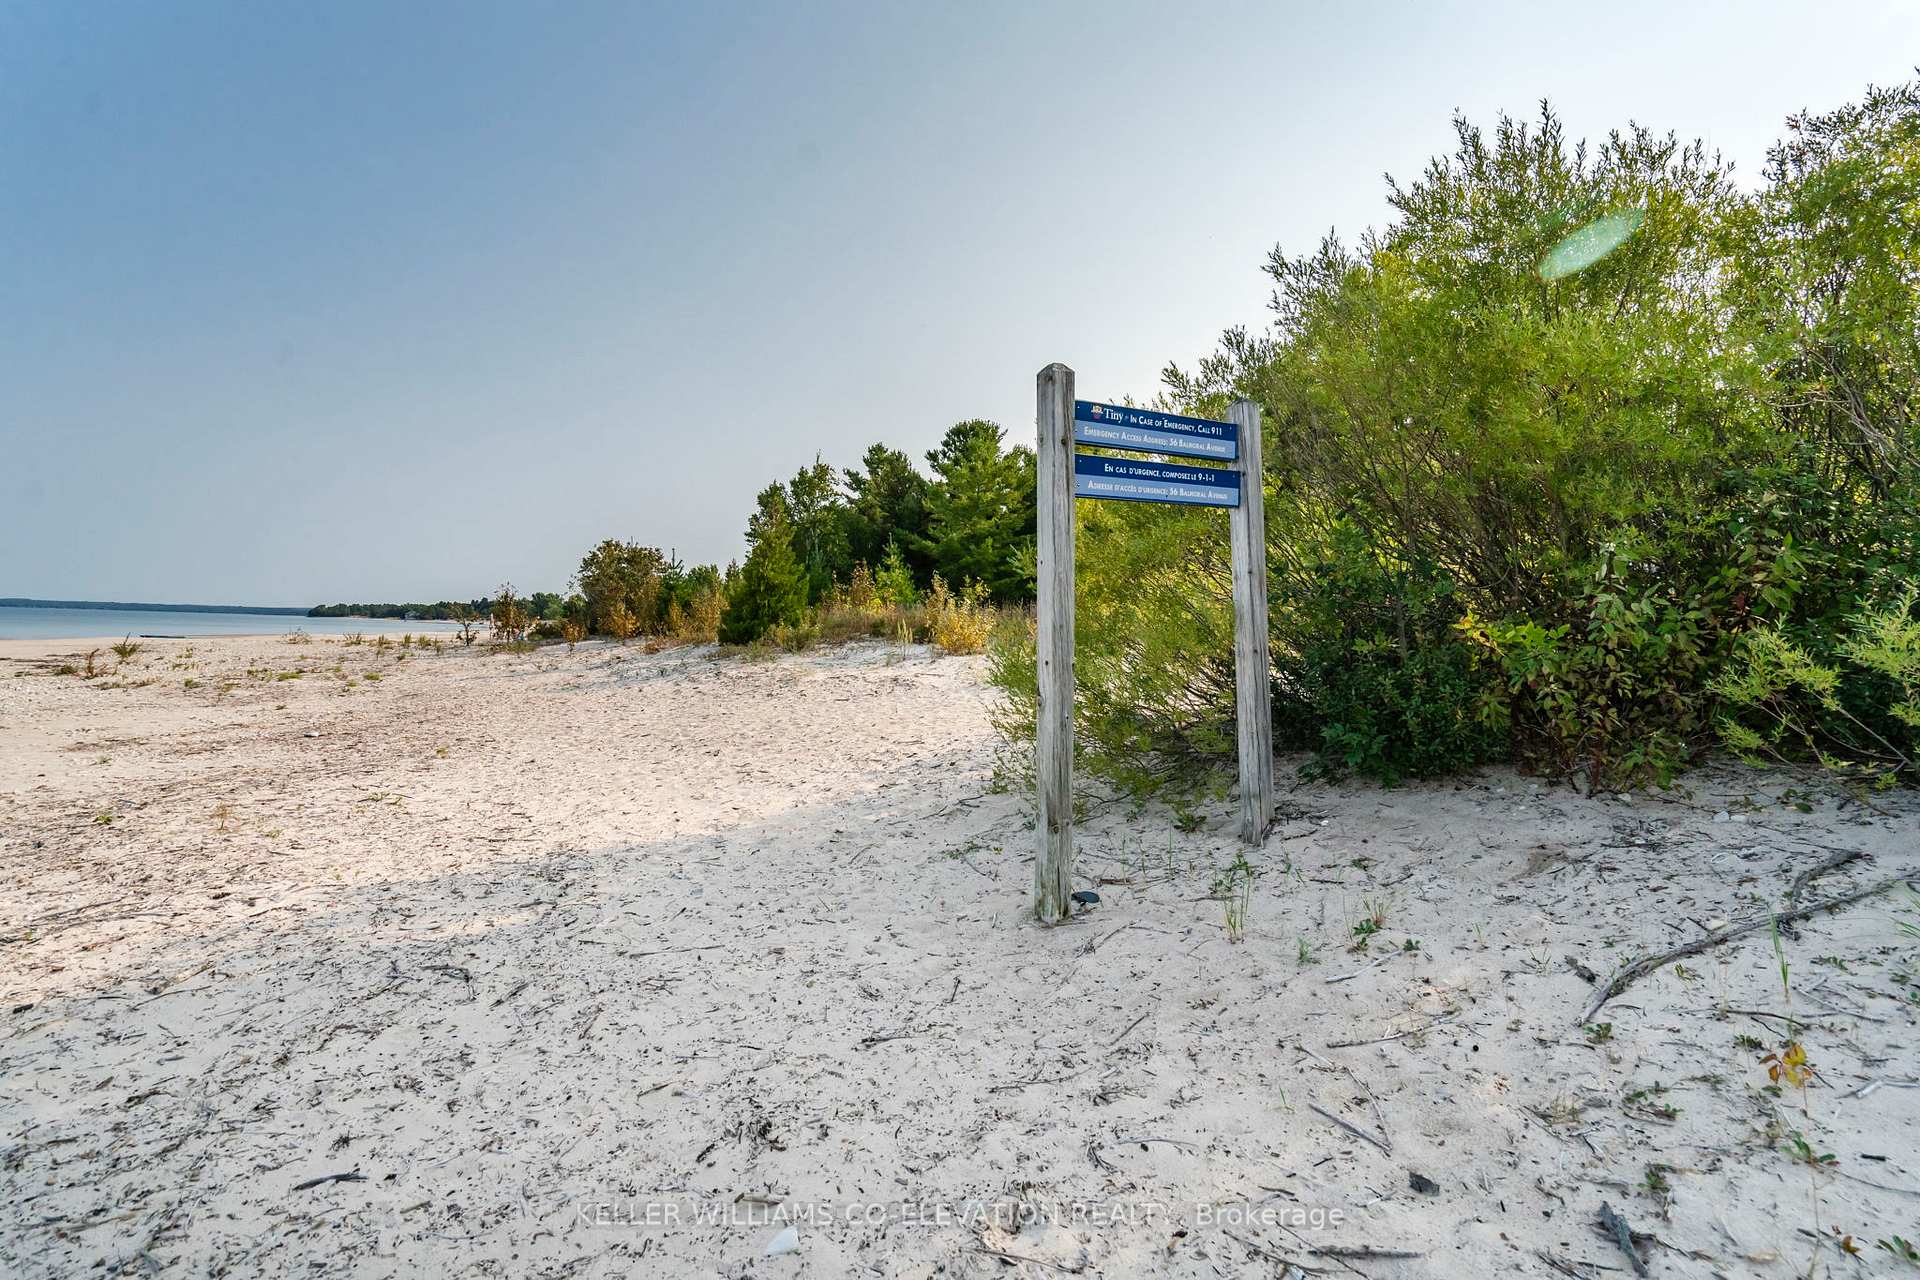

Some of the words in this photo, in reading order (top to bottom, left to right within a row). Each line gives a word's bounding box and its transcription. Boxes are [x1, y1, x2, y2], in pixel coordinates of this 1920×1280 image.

[1104, 407, 1124, 424] Tiny
[1211, 426, 1222, 436] 911
[1169, 438, 1178, 447] 56
[1197, 472, 1215, 482] 9-1-1
[1169, 487, 1178, 496] 56
